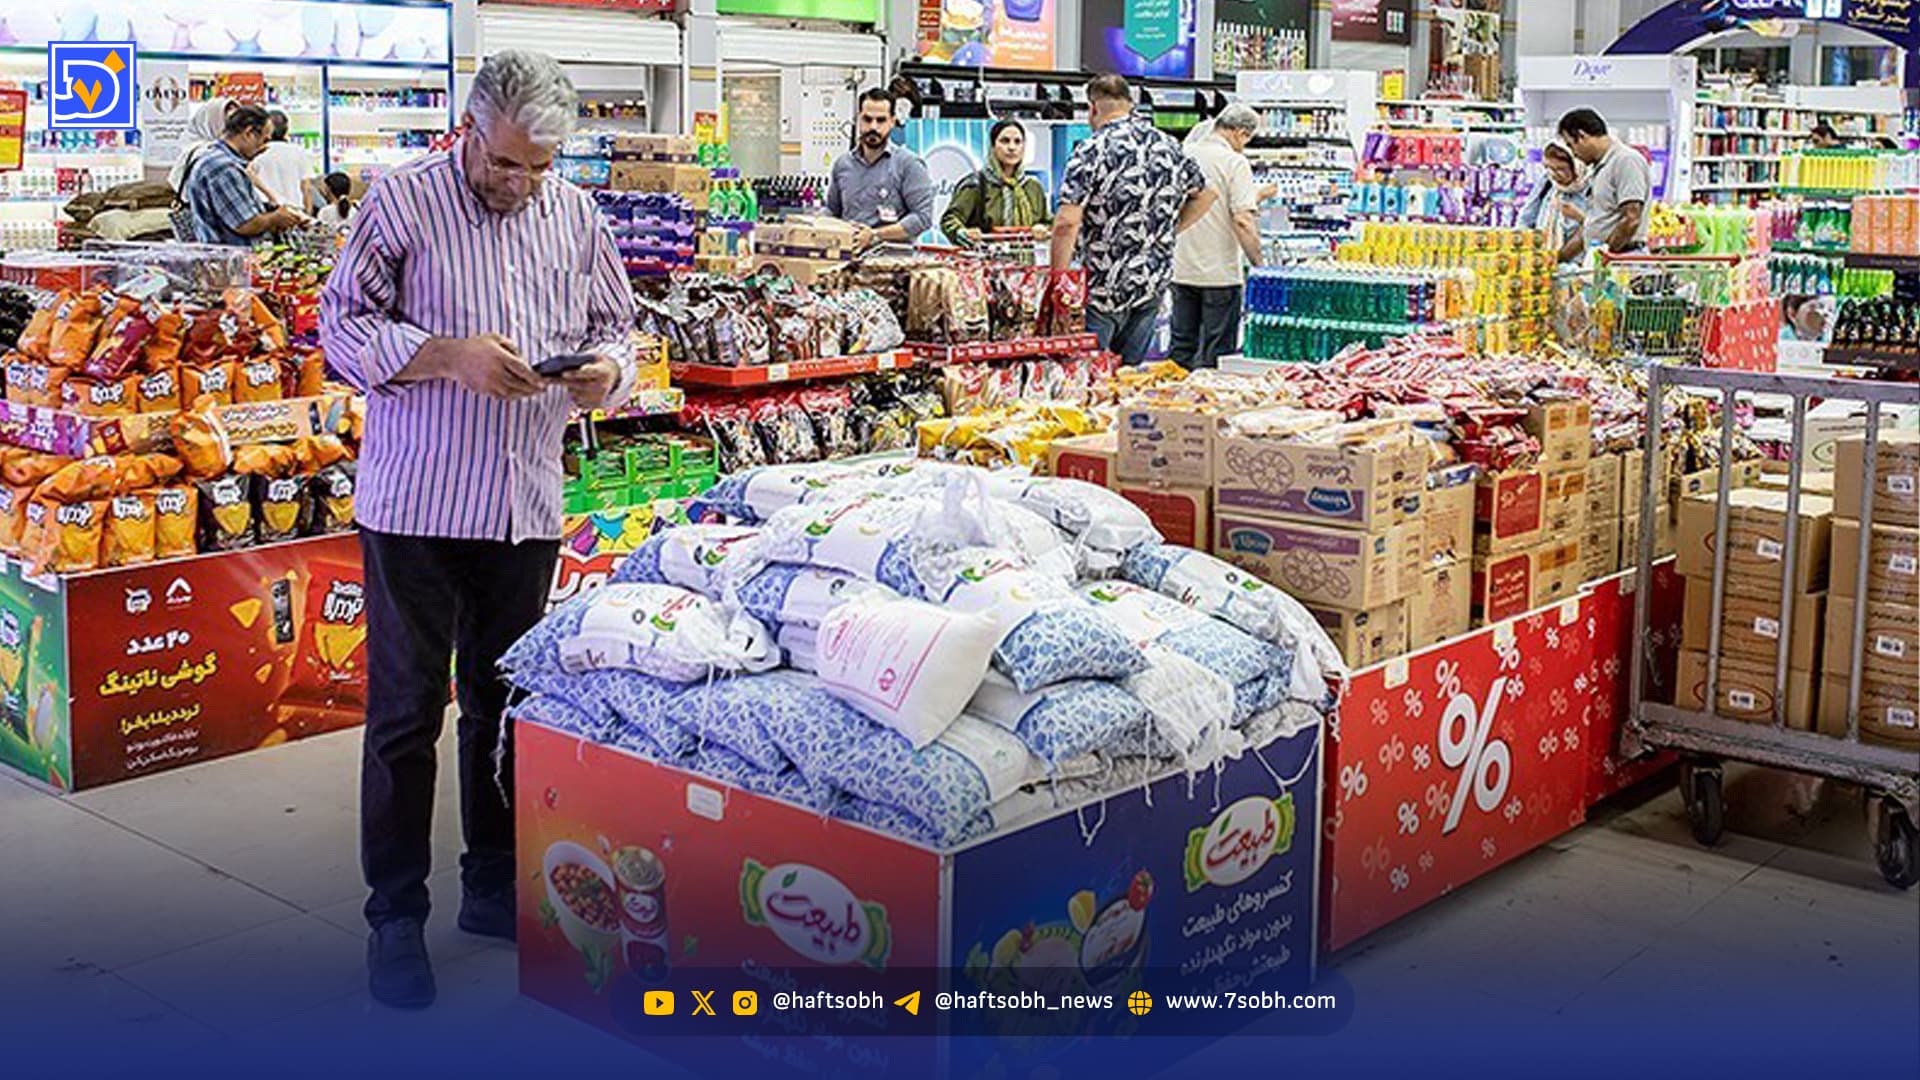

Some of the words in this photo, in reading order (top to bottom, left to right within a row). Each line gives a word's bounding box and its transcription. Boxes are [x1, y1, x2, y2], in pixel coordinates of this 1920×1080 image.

[160, 652, 217, 689] گوشی
[1206, 808, 1275, 870] طبیعت
[766, 893, 860, 955] طبیعت
[1182, 903, 1225, 938] طبیعت
[1227, 869, 1294, 925] کنسروهای
